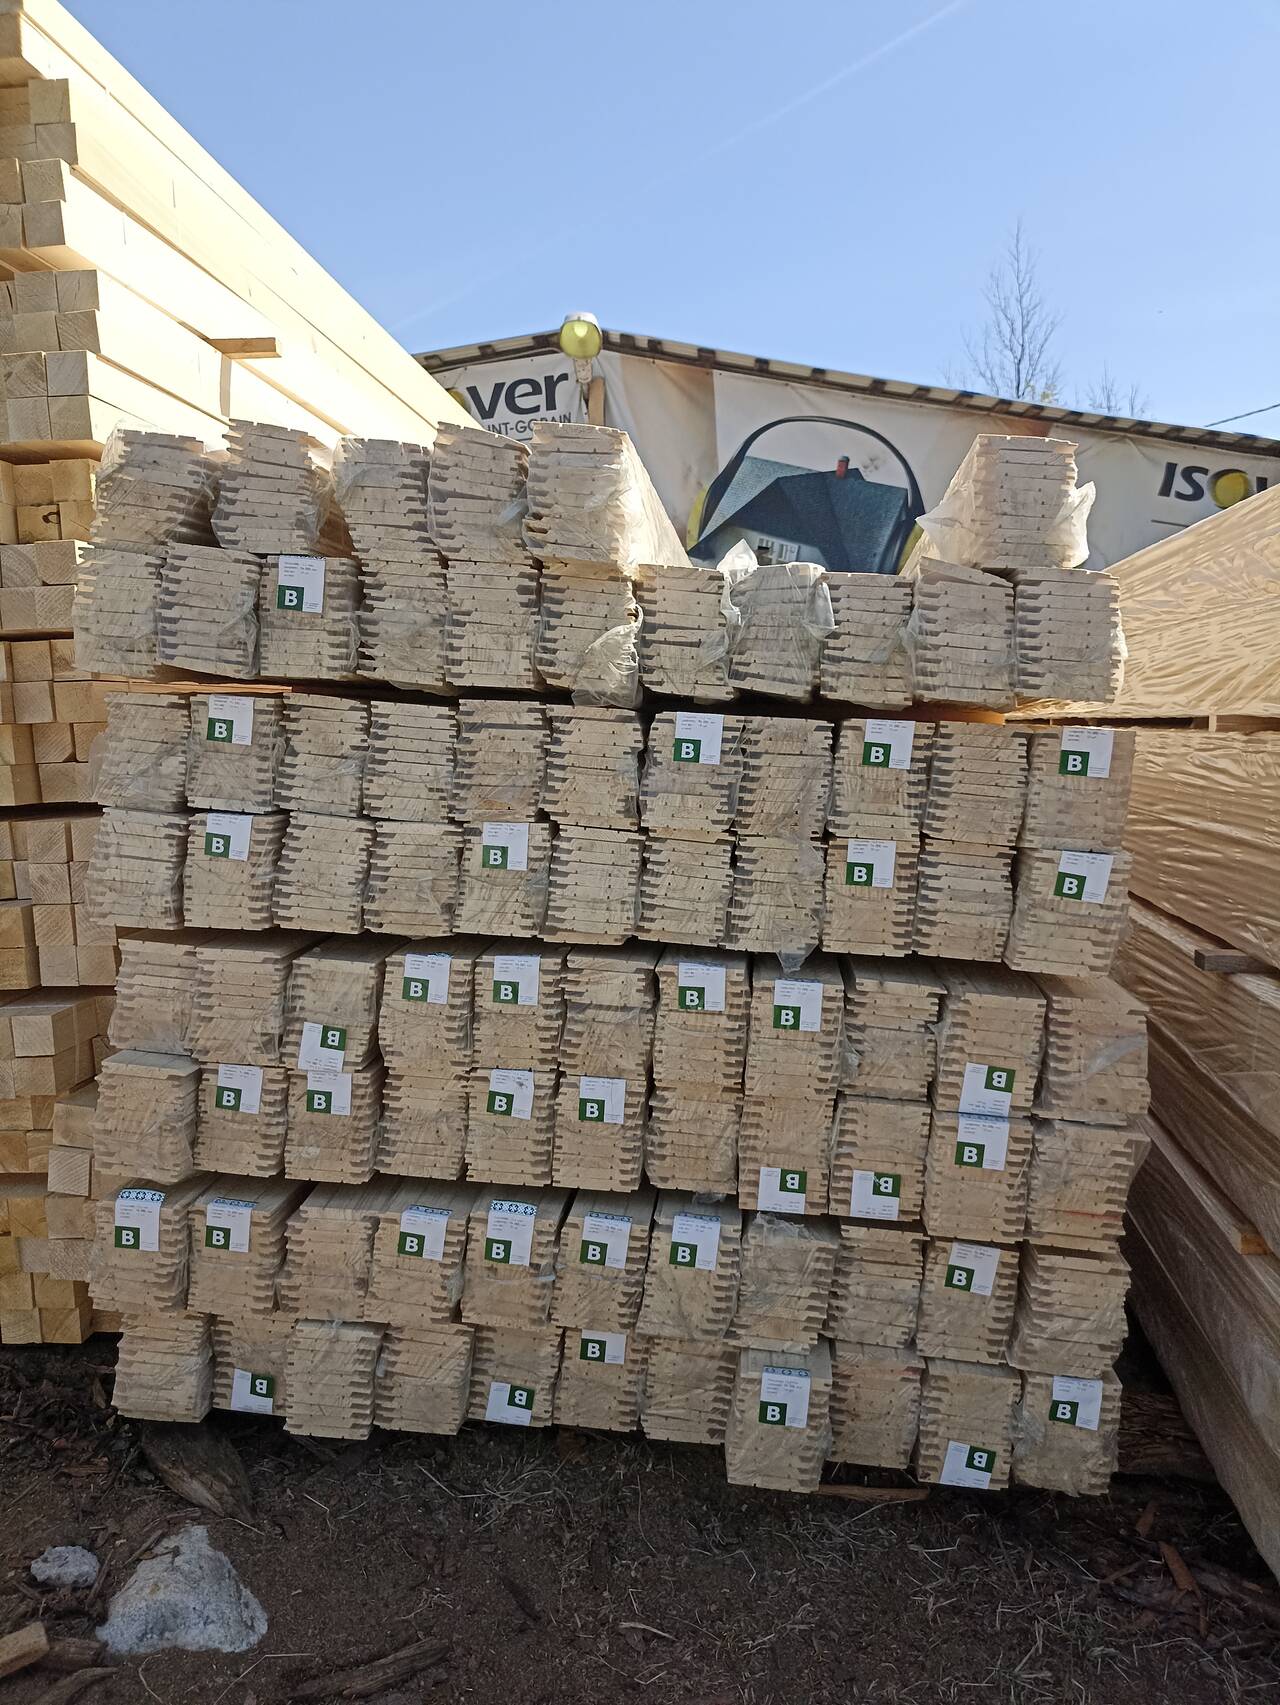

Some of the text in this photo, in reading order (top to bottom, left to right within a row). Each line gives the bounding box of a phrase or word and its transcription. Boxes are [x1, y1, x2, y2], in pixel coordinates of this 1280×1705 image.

[448, 373, 569, 420] ver
[1157, 459, 1269, 510] ISO
[284, 589, 298, 606] B
[214, 722, 228, 738] B
[680, 742, 695, 759] B
[870, 746, 885, 763] B
[1067, 754, 1082, 772] B
[211, 837, 225, 853] B
[489, 849, 503, 865] B
[853, 866, 868, 882] B
[1062, 877, 1079, 895] B
[409, 981, 423, 997] B
[500, 984, 513, 1000] B
[685, 990, 700, 1006] B
[780, 1009, 795, 1026] B
[327, 1030, 340, 1047] B
[992, 1071, 1007, 1088] B
[222, 1090, 236, 1106] B
[313, 1093, 327, 1109] B
[493, 1095, 507, 1112] B
[585, 1102, 599, 1118] B
[962, 1146, 978, 1163] B
[785, 1173, 800, 1190] B
[879, 1177, 893, 1193] B
[121, 1229, 135, 1245] B
[212, 1230, 225, 1246] B
[404, 1236, 419, 1252] B
[491, 1242, 505, 1259] B
[587, 1244, 601, 1261] B
[676, 1246, 691, 1263] B
[952, 1269, 967, 1286] B
[587, 1342, 601, 1358] B
[255, 1378, 268, 1394] B
[514, 1390, 528, 1406] B
[766, 1405, 781, 1422] B
[1056, 1403, 1071, 1420] B
[973, 1451, 988, 1468] B
